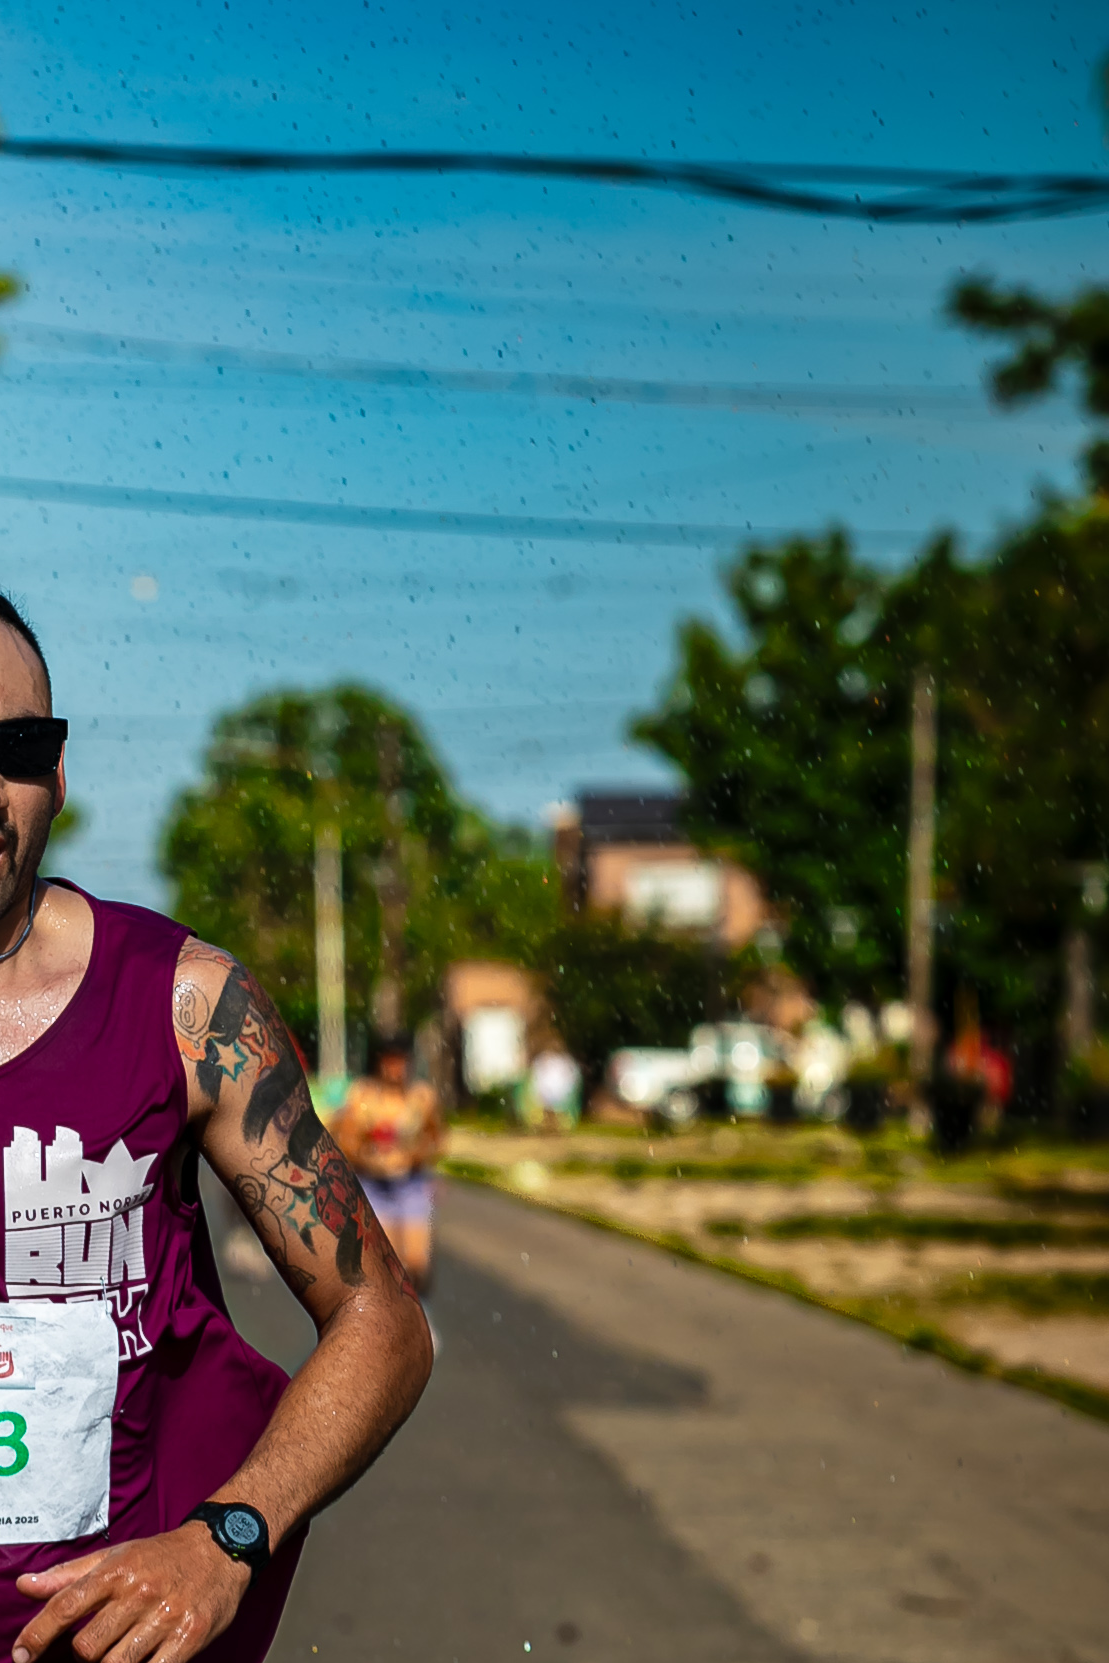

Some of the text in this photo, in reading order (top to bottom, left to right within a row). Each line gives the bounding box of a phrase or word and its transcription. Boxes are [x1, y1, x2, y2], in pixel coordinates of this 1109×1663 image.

[12, 1203, 91, 1223] PUERTO
[5, 1205, 146, 1285] RUN
[14, 1515, 40, 1524] 2025
